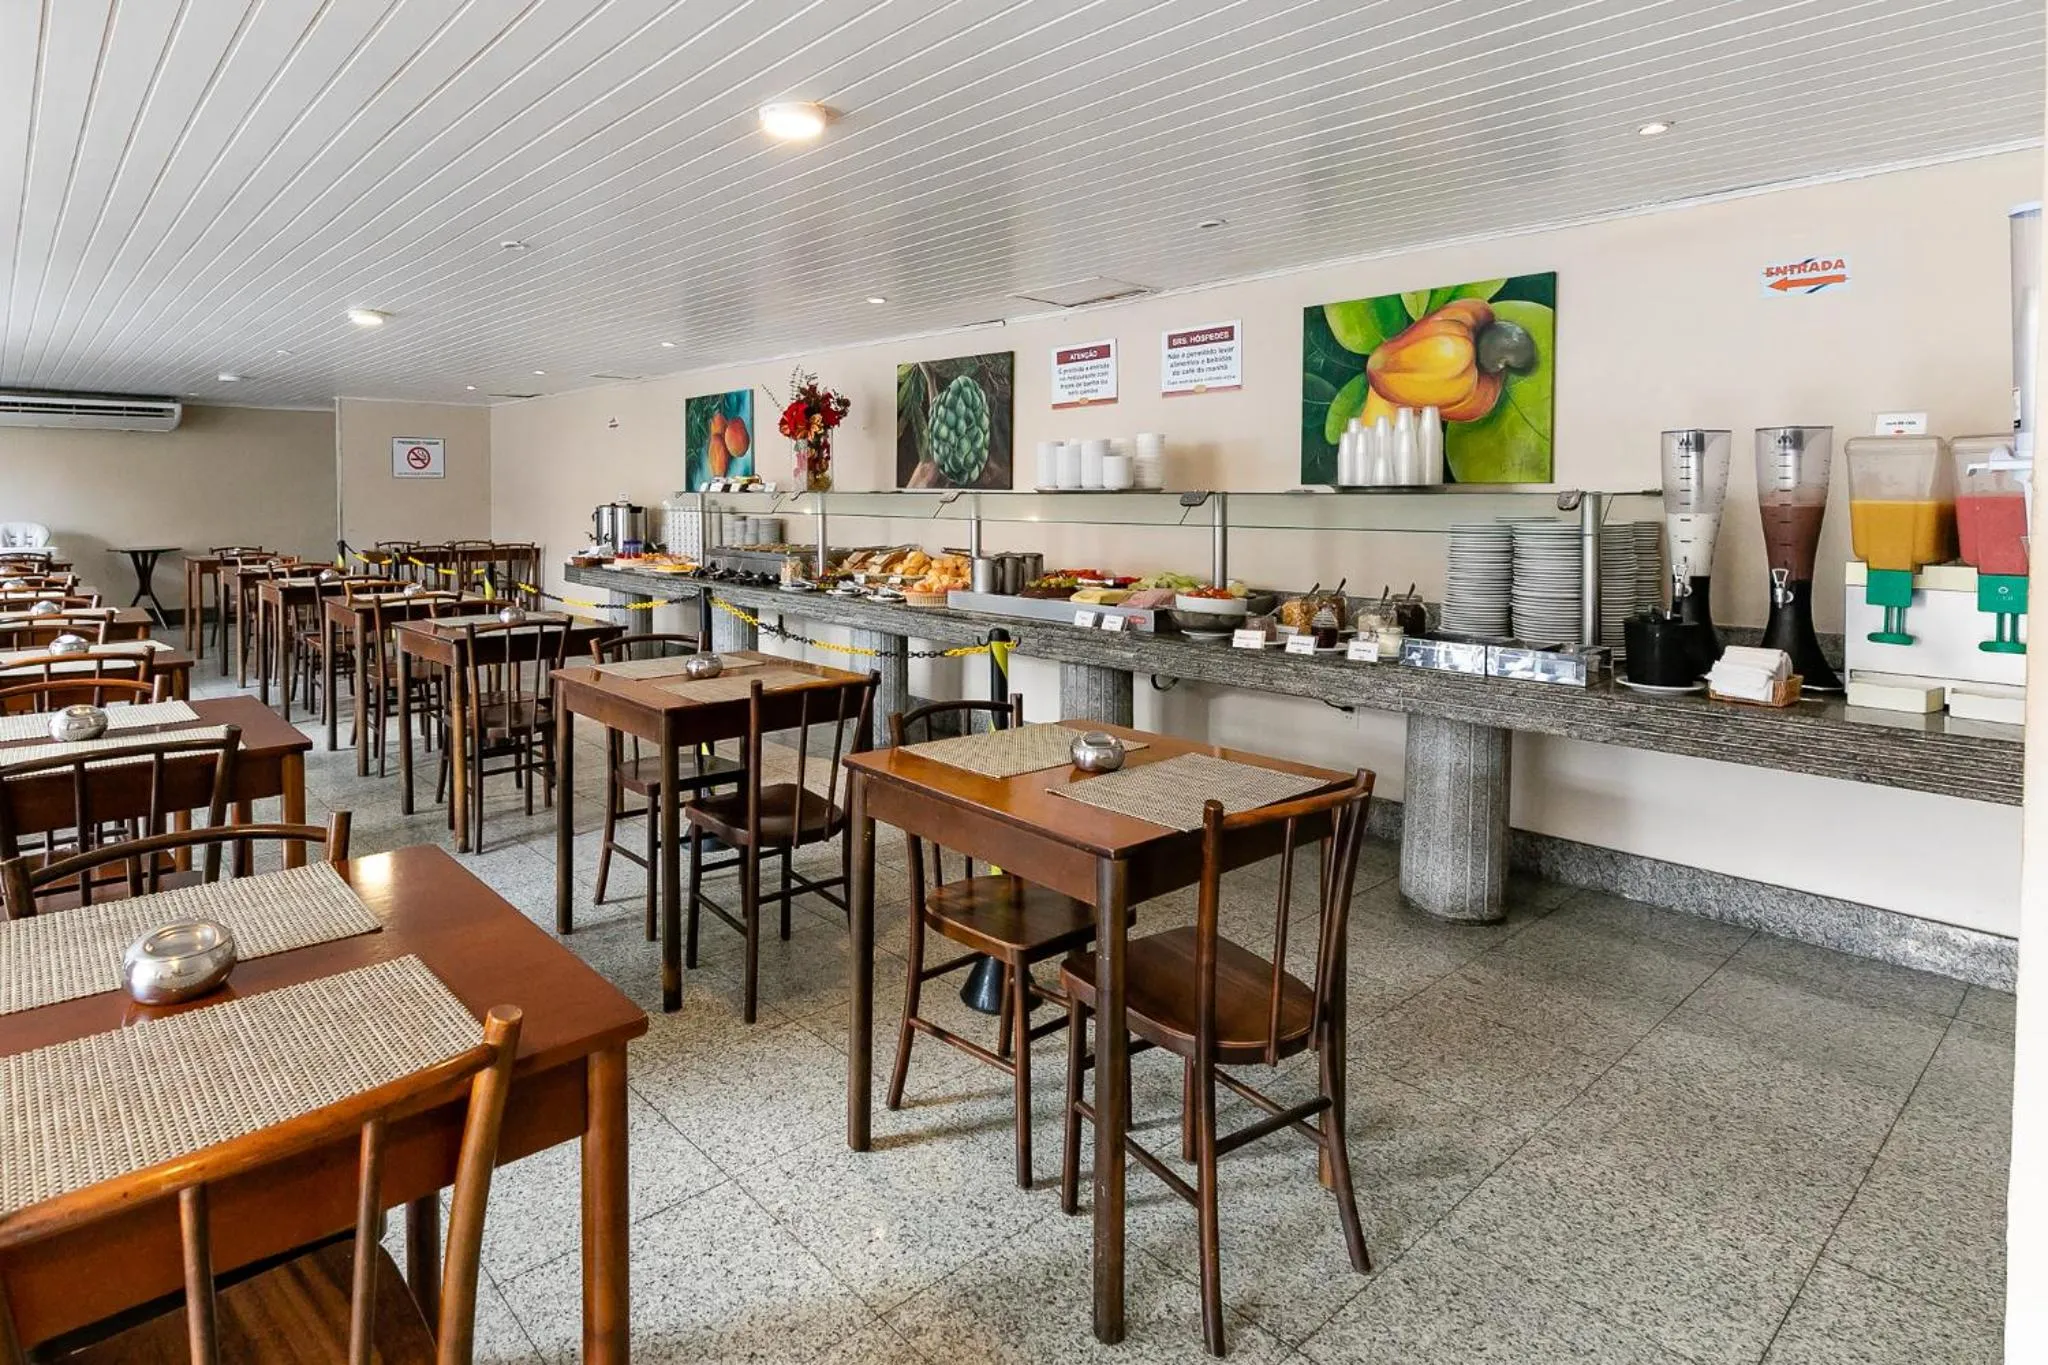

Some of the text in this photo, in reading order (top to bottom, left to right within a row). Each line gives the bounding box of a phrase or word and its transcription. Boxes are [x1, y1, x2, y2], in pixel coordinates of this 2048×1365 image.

[1766, 259, 1845, 277] ENTRADA
[1070, 350, 1098, 360] ATENÇÃO
[1206, 355, 1232, 364] bebidas
